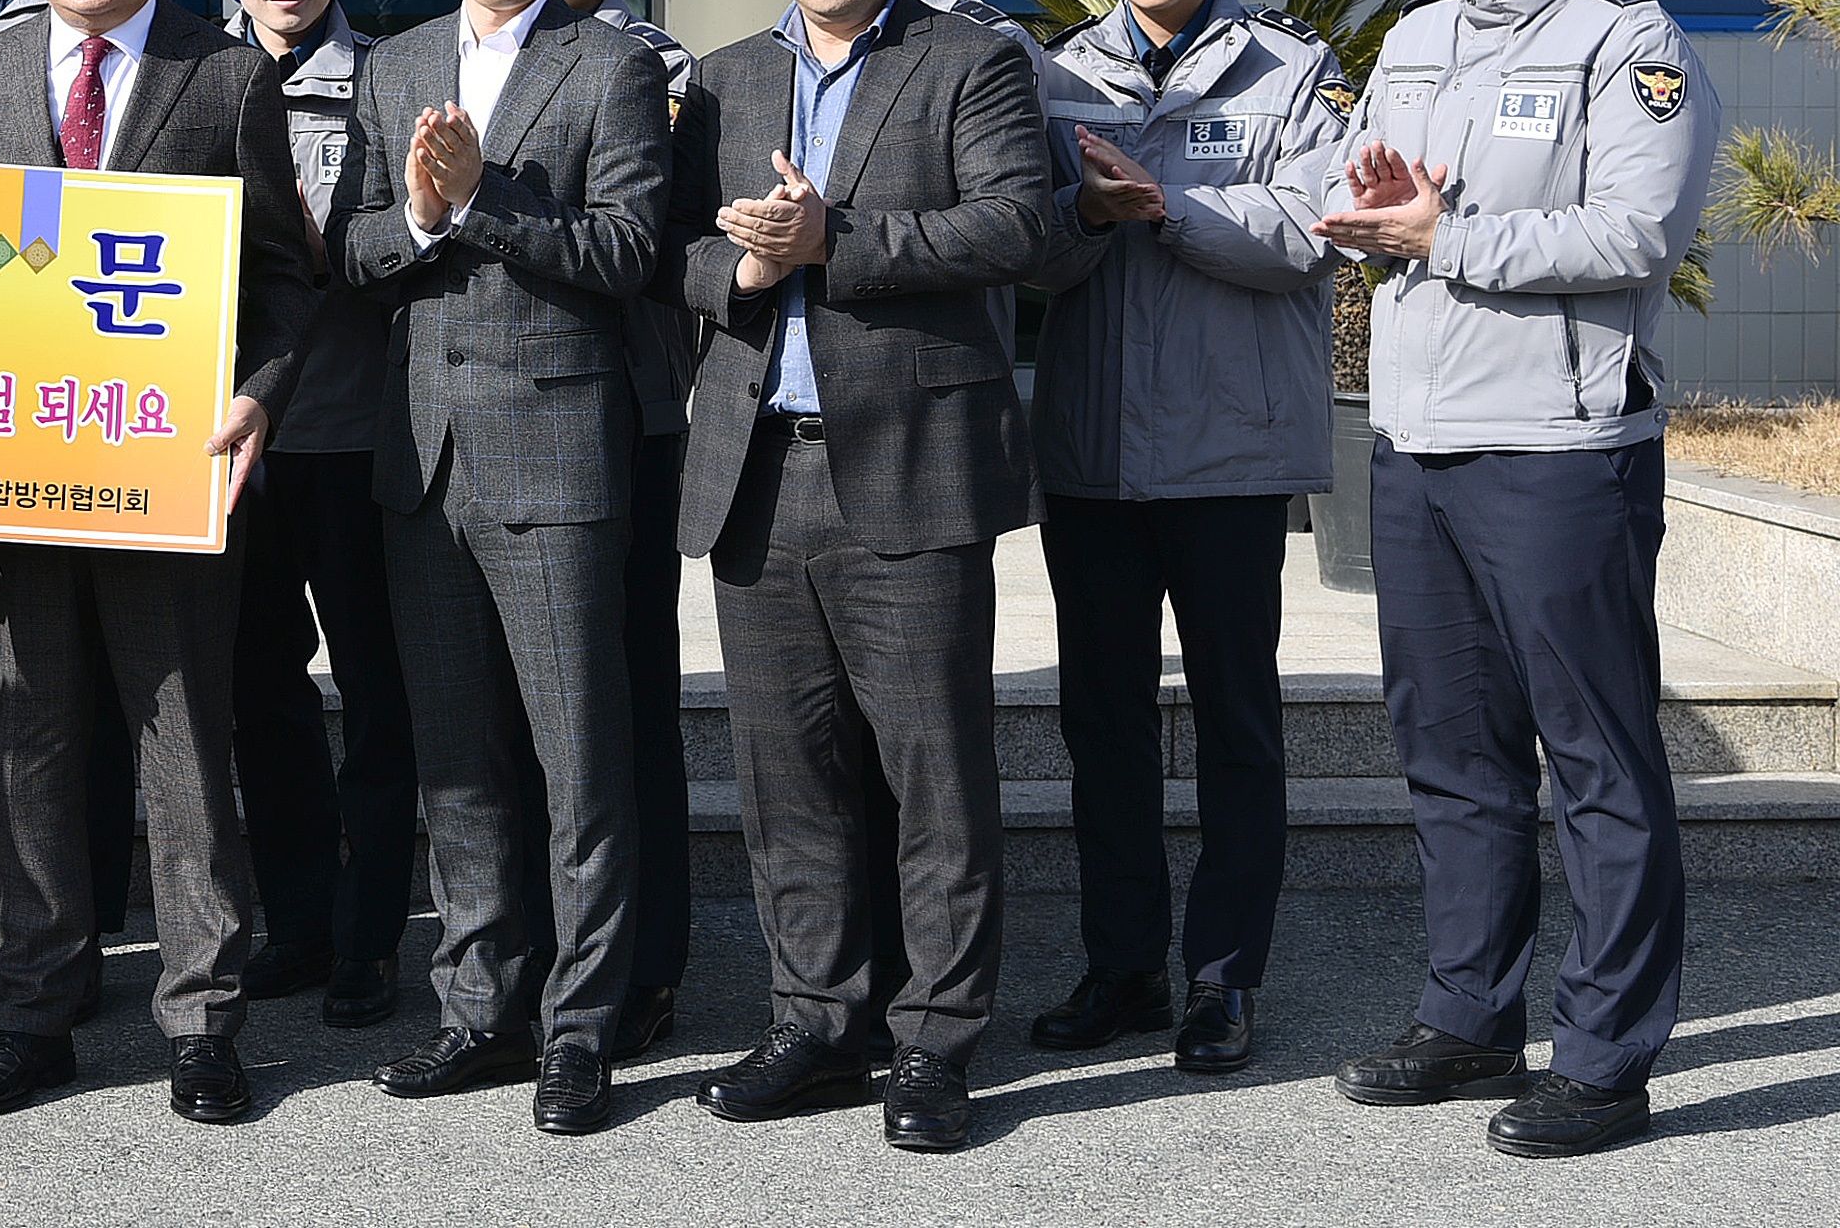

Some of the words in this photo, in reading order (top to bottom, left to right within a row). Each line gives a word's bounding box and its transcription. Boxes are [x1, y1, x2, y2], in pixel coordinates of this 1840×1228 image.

[1505, 93, 1554, 119] 경찰
[1194, 121, 1244, 142] 경찰
[1500, 120, 1551, 133] POLICE
[1192, 143, 1243, 155] POLICE
[71, 232, 184, 336] 문
[36, 379, 174, 442] 되세요
